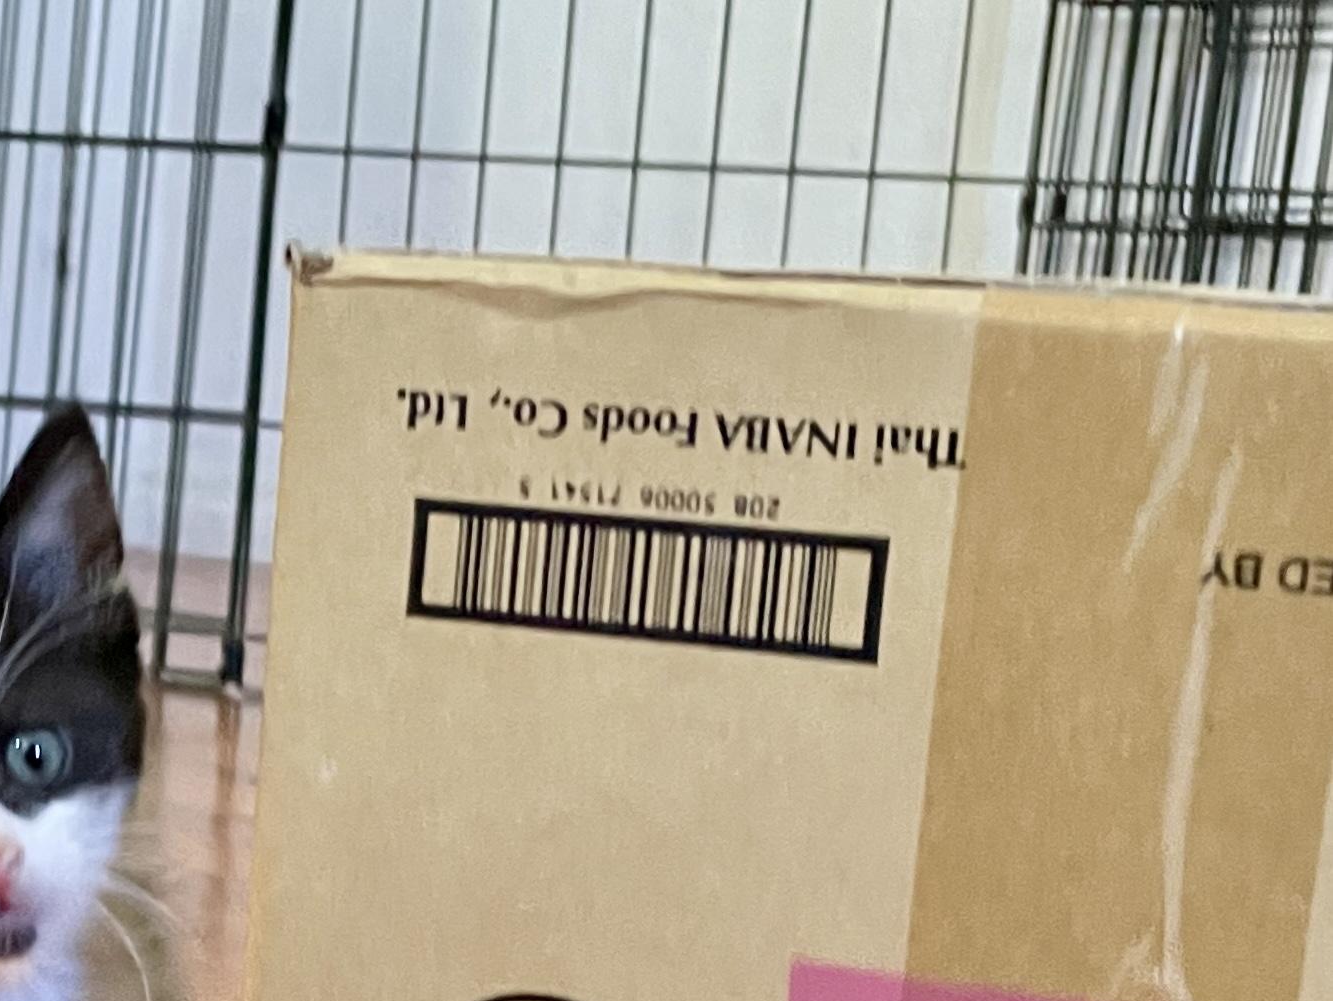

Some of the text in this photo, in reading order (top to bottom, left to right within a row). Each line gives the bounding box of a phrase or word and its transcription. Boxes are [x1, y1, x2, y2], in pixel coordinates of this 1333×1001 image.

[396, 387, 966, 471] Thai INABA Foods Co., Ltd.
[1201, 550, 1263, 592] BY
